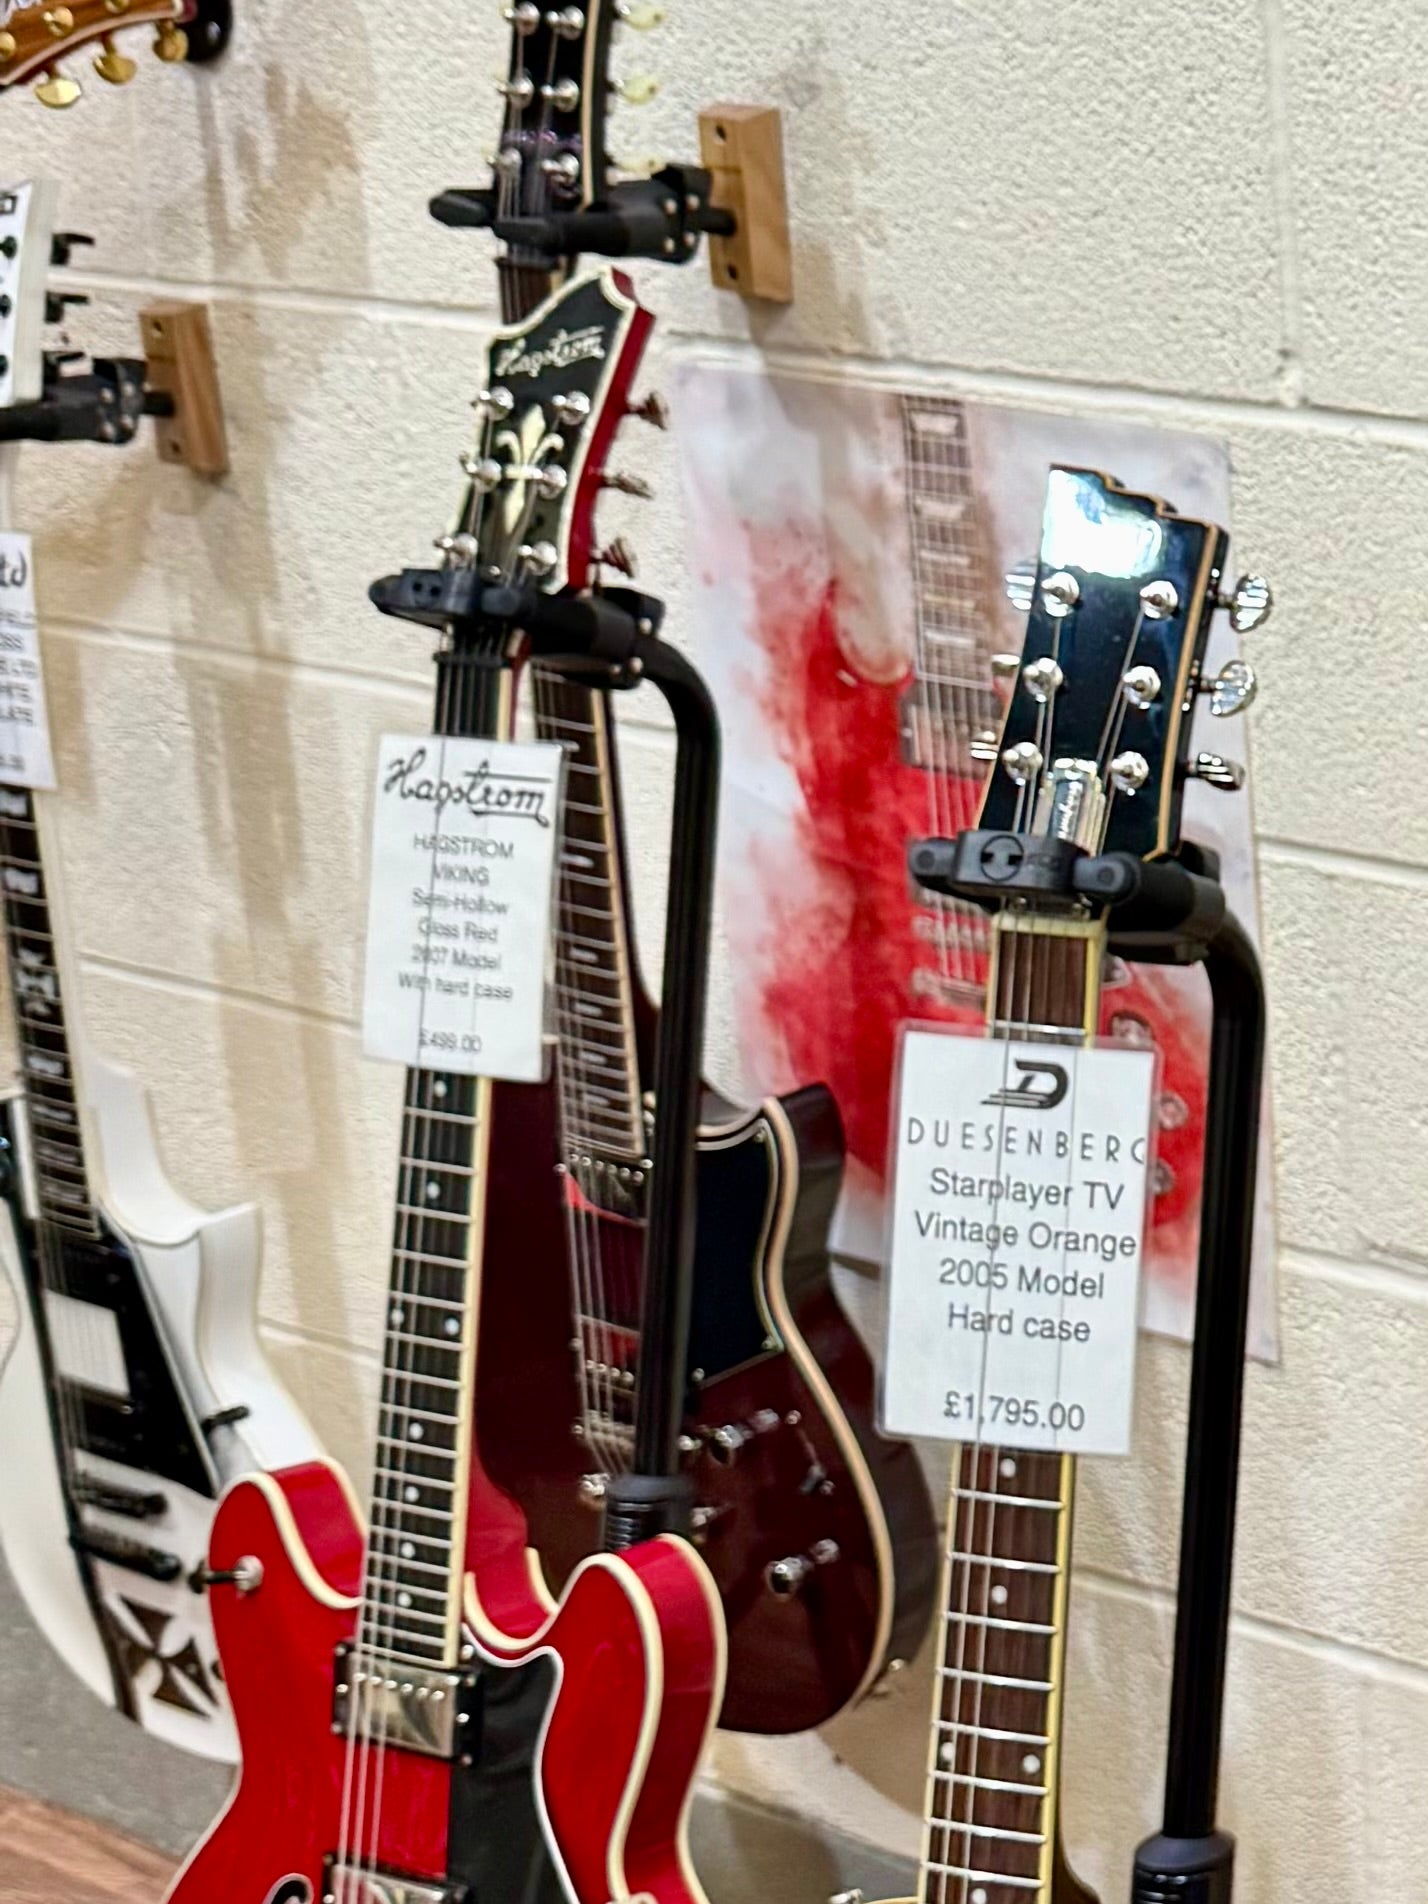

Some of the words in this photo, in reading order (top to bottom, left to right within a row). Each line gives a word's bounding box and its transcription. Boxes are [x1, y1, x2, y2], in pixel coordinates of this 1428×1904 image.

[929, 1167, 1073, 1210] Starplayer
[1083, 1180, 1125, 1211] TV
[915, 1209, 1019, 1253] Vintage
[1028, 1221, 1137, 1262] Orange
[938, 1257, 1008, 1290] 2005
[1017, 1266, 1105, 1299] Model
[947, 1302, 1014, 1337] Hard
[1023, 1313, 1091, 1343] case
[942, 1390, 1086, 1432] £1,795.00
